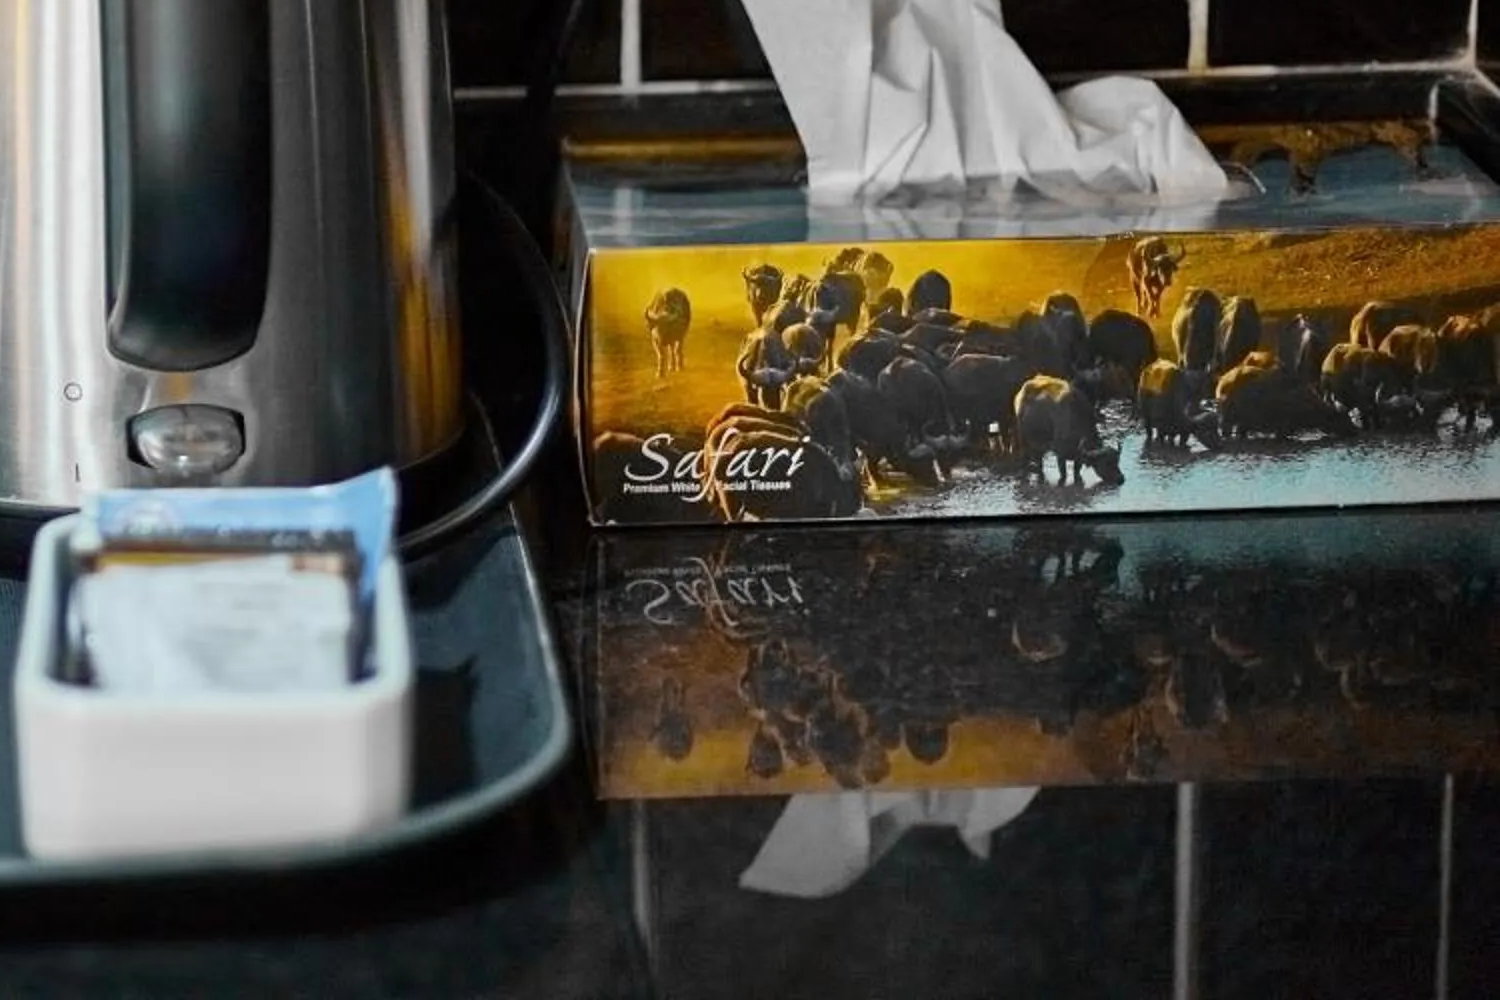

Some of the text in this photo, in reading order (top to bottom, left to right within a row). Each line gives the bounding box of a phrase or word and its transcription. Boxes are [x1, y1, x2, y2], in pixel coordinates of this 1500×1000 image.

[622, 482, 669, 493] Premium
[672, 481, 701, 493] White
[750, 479, 791, 491] Tissues
[623, 427, 810, 503] Safari
